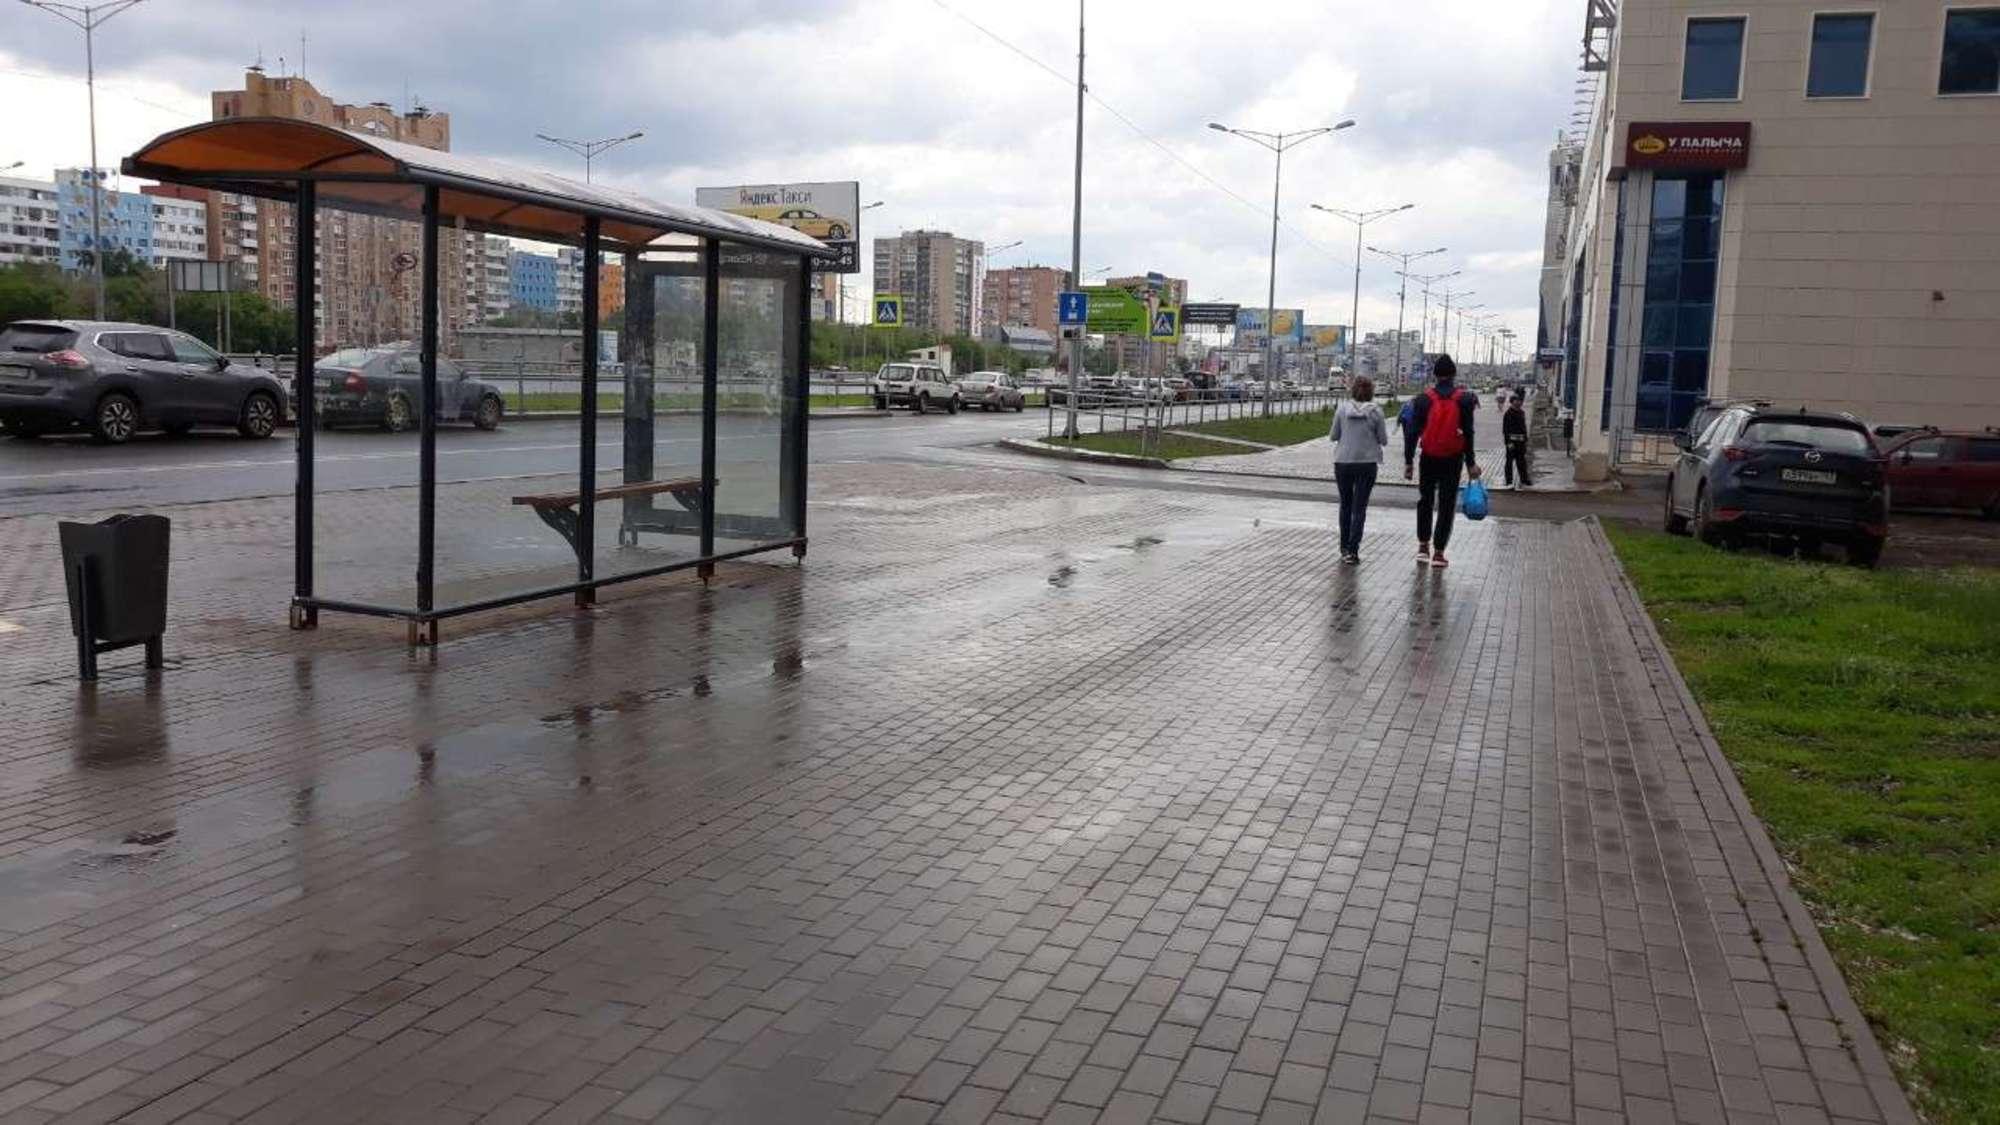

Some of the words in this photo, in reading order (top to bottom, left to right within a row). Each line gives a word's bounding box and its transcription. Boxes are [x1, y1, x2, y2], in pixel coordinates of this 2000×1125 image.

[1667, 137, 1678, 148] У
[1681, 137, 1742, 148] ПАЛЫЧА
[779, 188, 812, 204] Такси
